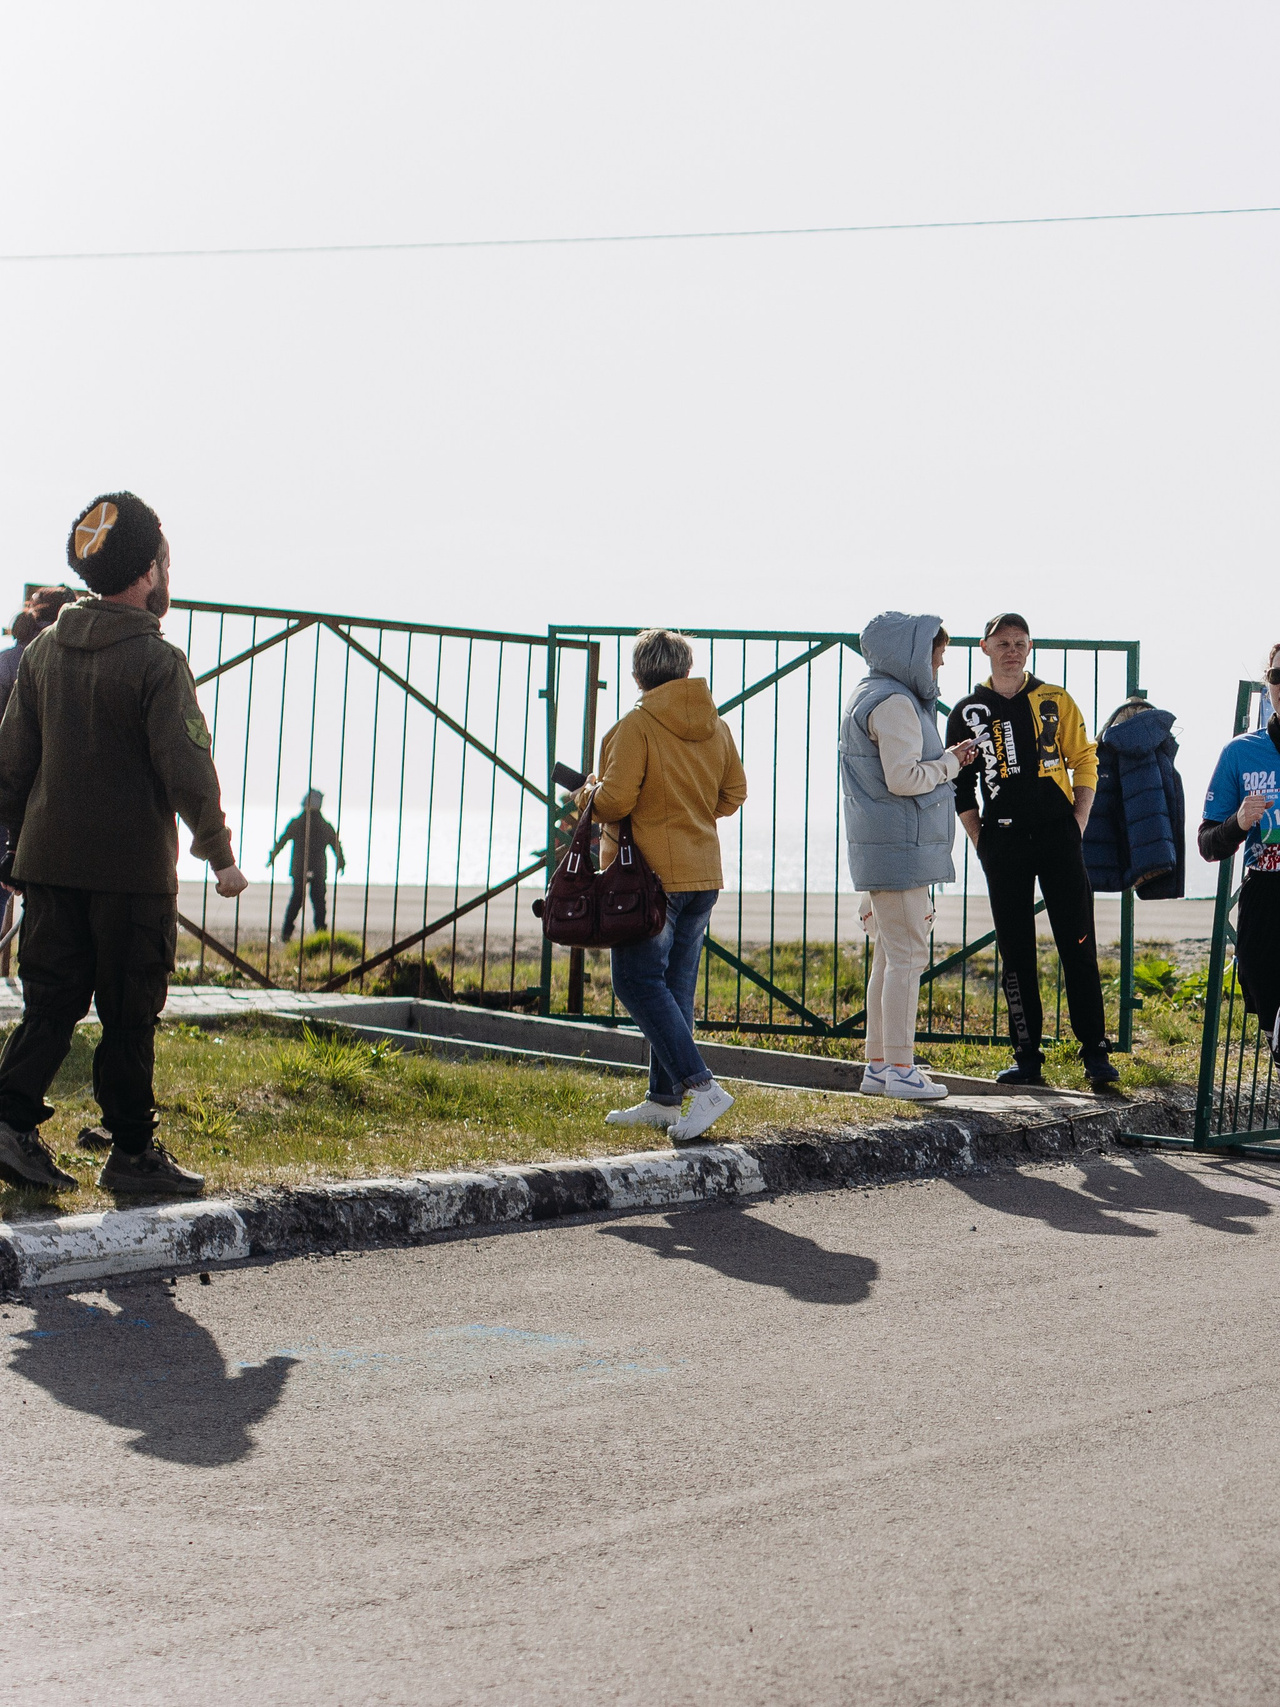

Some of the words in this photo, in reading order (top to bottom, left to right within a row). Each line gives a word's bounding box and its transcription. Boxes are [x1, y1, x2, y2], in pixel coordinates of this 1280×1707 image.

[1242, 770, 1277, 791] 2024
[1006, 971, 1021, 1007] JUST
[1012, 1011, 1026, 1033] DO
